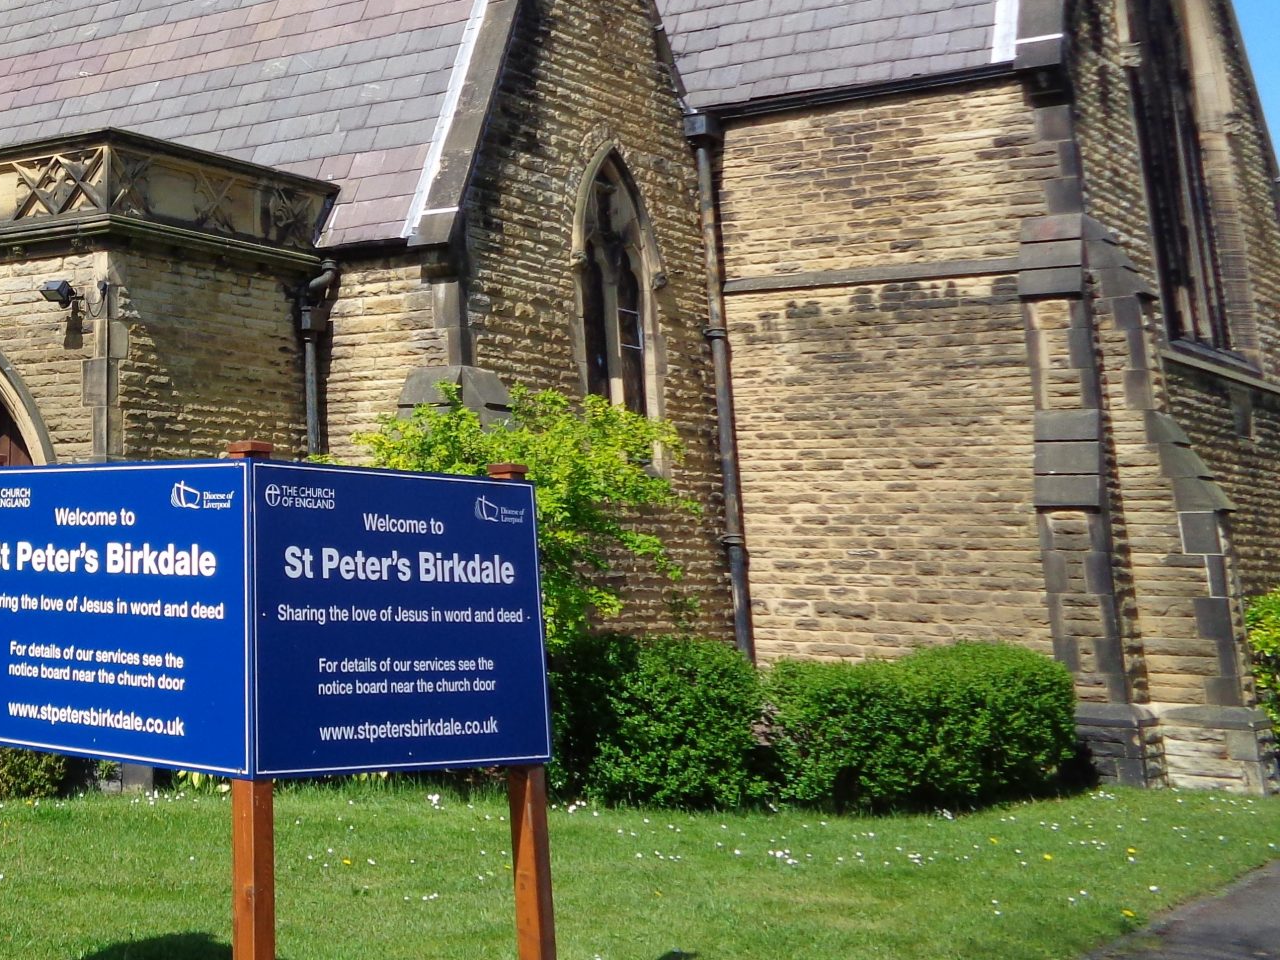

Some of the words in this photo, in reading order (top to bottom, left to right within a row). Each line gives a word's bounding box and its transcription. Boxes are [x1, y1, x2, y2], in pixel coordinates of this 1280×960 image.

[2, 488, 30, 498] CHURCH
[203, 491, 225, 500] Diocese
[226, 490, 235, 500] of
[282, 485, 298, 497] THE
[299, 486, 335, 498] CHURCH
[203, 499, 231, 510] Liverpool
[282, 497, 295, 507] OF
[296, 498, 335, 509] ENGLAND
[55, 507, 117, 526] Welcome
[120, 508, 135, 526] to
[363, 513, 427, 534] Welcome
[430, 518, 444, 534] to
[16, 542, 98, 573] Peter's
[106, 543, 216, 576] Birkdale
[285, 546, 313, 579] St
[322, 547, 411, 582] Peter's
[419, 551, 514, 584] Birkdale
[21, 594, 37, 610] the
[40, 596, 63, 611] love
[66, 596, 77, 612] of
[80, 597, 113, 614] Jesus
[117, 598, 128, 614] in
[131, 599, 160, 616] word
[164, 601, 188, 618] and
[191, 602, 224, 619] deed
[278, 604, 326, 625] Sharing
[329, 605, 349, 622] the
[352, 606, 377, 622] love
[380, 606, 392, 622] of
[395, 607, 429, 622] Jesus
[431, 607, 442, 622] in
[444, 608, 471, 622] word
[474, 608, 494, 623] and
[497, 608, 523, 623] deed
[10, 641, 26, 656] For
[28, 643, 61, 659] details
[63, 645, 74, 660] of
[76, 649, 93, 662] our
[96, 650, 139, 665] services
[142, 654, 162, 667] see
[165, 653, 183, 669] the
[319, 658, 338, 673] For
[340, 658, 377, 672] details
[380, 657, 390, 672] of
[393, 661, 411, 672] our
[413, 658, 456, 671] services
[458, 660, 475, 671] see
[478, 657, 494, 670] the
[9, 663, 38, 677] notice
[41, 664, 70, 680] board
[73, 670, 95, 682] near
[98, 668, 115, 684] the
[117, 669, 155, 687] church
[158, 672, 185, 690] door
[318, 680, 353, 695] notice
[356, 679, 387, 694] board
[390, 682, 413, 693] near
[417, 679, 434, 692] the
[436, 678, 470, 692] church
[473, 678, 496, 691] door
[8, 702, 185, 736] www.stpetersbirkdale.co.uk
[320, 717, 498, 742] www.stpetersbirkdale.co.uk
